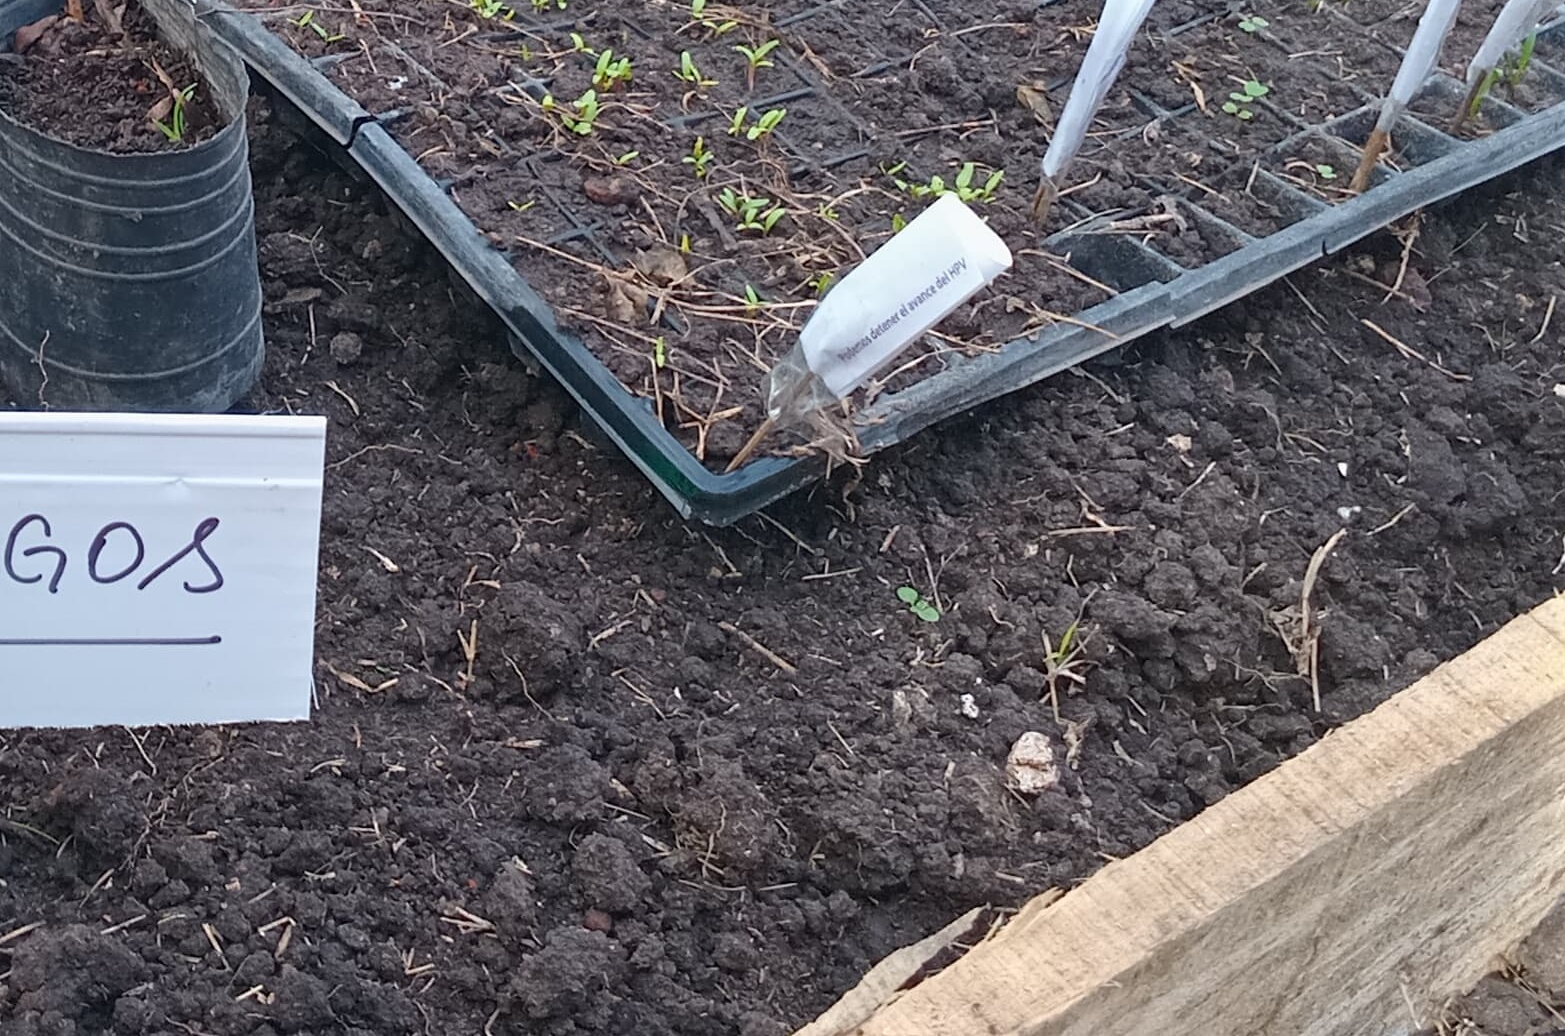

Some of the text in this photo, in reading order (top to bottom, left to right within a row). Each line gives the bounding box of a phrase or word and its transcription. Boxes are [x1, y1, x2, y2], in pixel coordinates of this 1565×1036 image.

[837, 257, 969, 363] Podemos detener el avance del HPV
